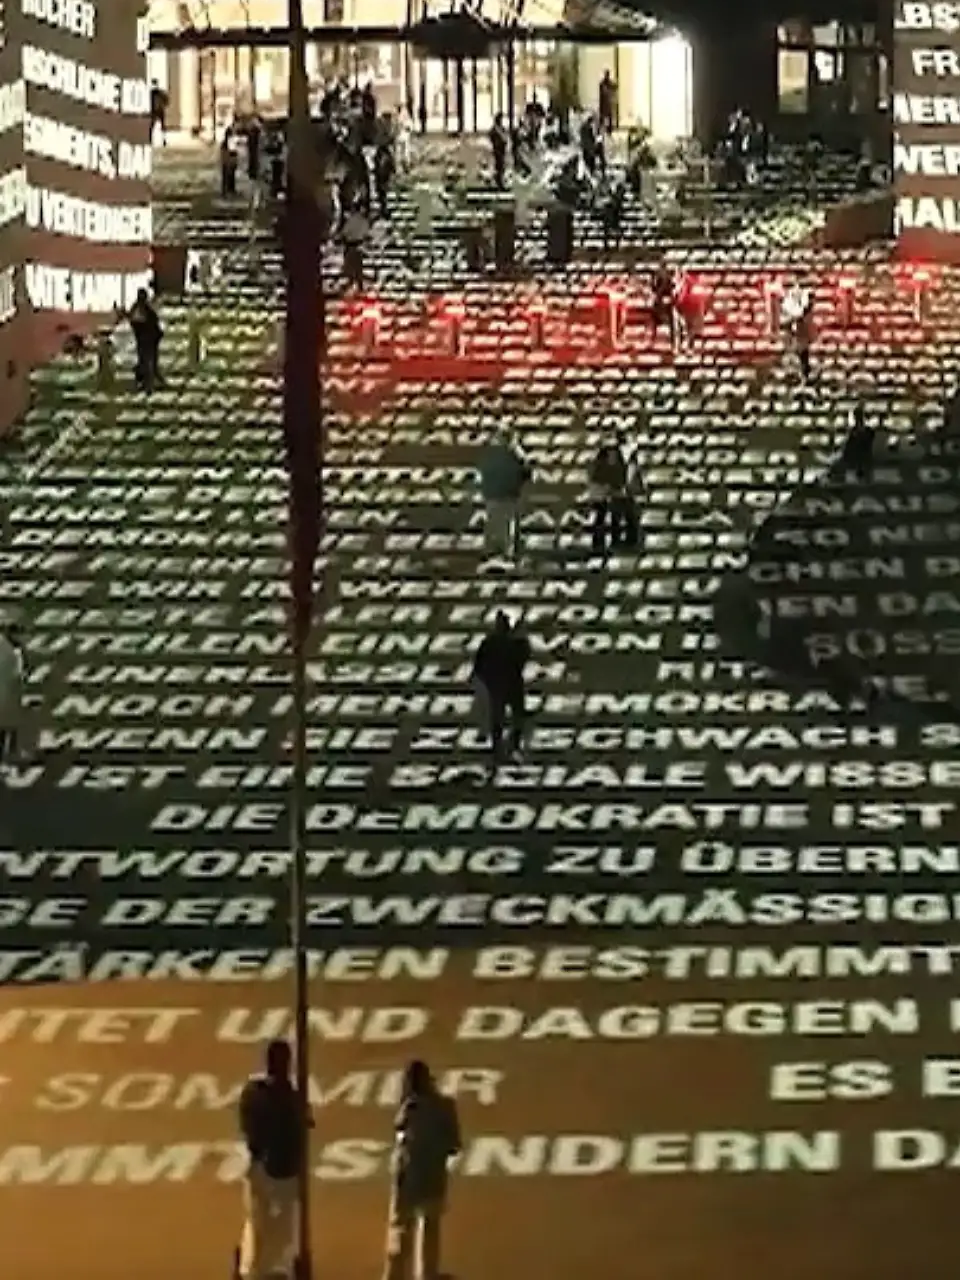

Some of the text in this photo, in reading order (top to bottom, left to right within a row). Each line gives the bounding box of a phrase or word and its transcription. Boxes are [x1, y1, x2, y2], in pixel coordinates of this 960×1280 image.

[527, 629, 663, 652] VON
[37, 727, 267, 751] WENN
[529, 723, 898, 750] SCHWACH
[57, 765, 186, 788] IST
[149, 803, 287, 833] DIE
[829, 801, 957, 830] IST
[544, 846, 653, 875] ZU
[101, 896, 276, 927] DER
[454, 997, 920, 1041] DAGEGEN
[769, 1060, 895, 1101] ES
[312, 1128, 843, 1183] SNDERN
